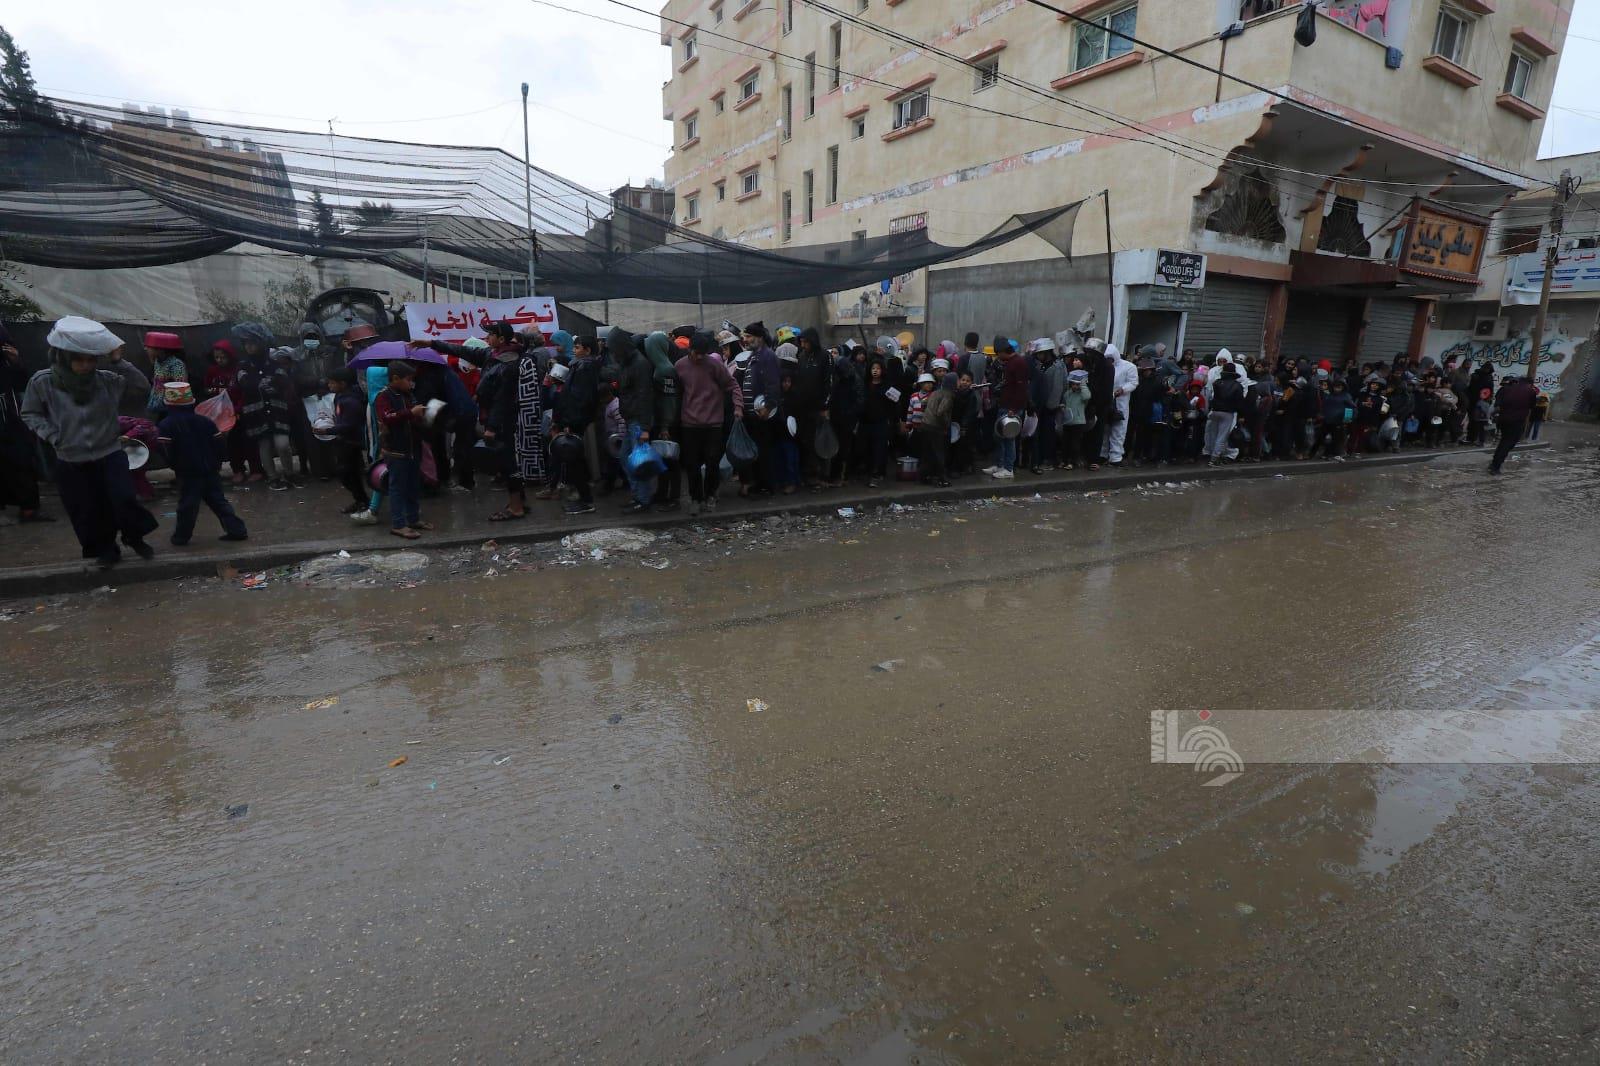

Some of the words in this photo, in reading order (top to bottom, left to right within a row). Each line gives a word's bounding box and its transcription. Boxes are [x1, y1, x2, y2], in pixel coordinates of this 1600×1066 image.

[1165, 264, 1181, 275] GOOD
[1182, 266, 1193, 276] LIFE
[424, 309, 474, 336] الخير
